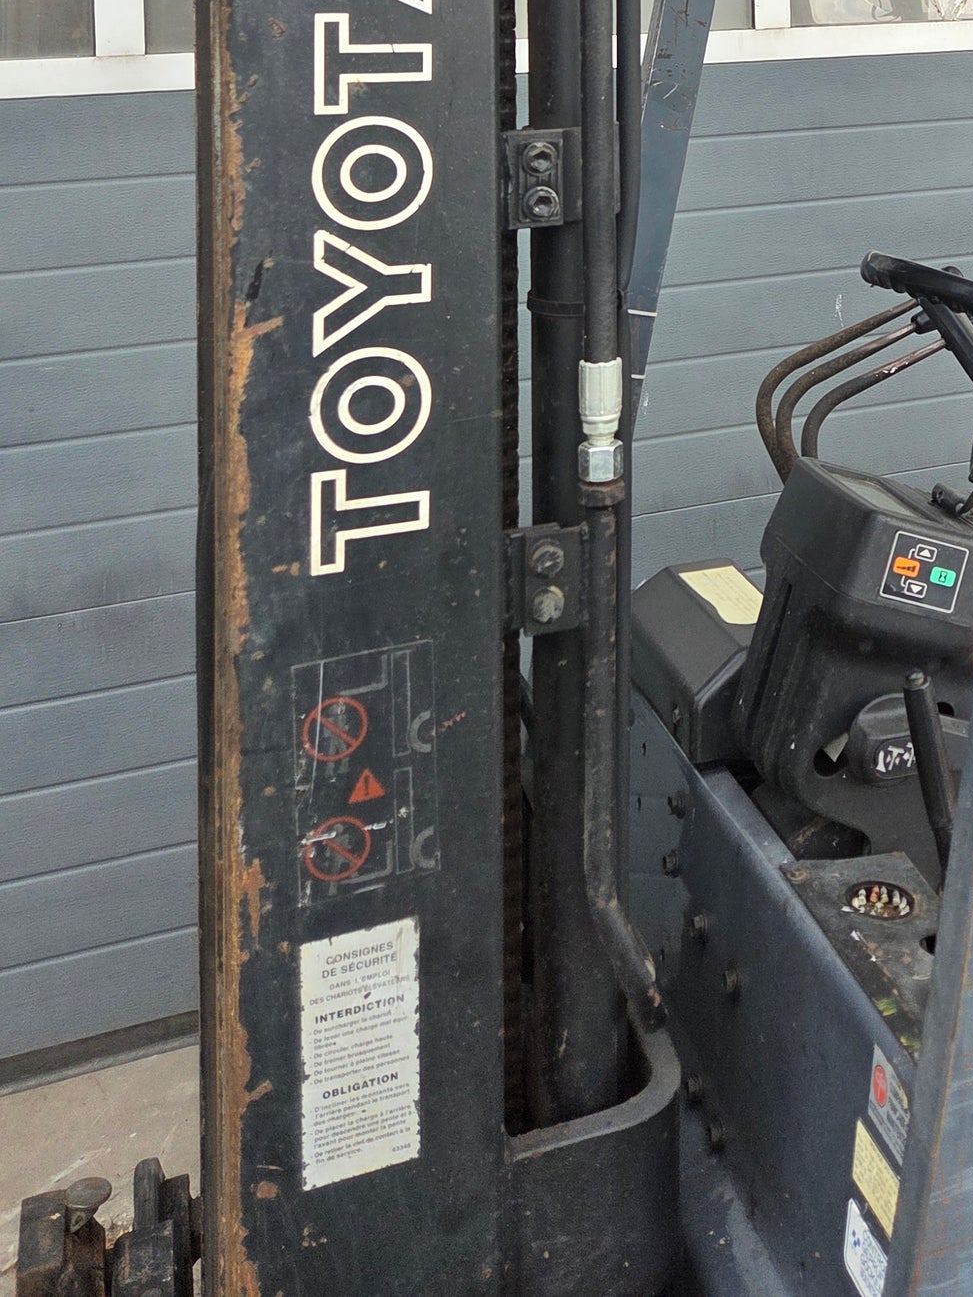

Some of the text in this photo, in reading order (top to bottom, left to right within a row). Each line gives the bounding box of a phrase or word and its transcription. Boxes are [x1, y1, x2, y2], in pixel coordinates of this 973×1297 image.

[322, 951, 397, 980] DE SÉCURITÉ
[326, 941, 394, 966] CONSIGNES
[309, 996, 324, 1006] DES
[326, 986, 362, 1002] CHARIOTS
[330, 979, 351, 990] DANS
[315, 993, 404, 1025] INTERDICTION
[322, 1071, 398, 1100] OBLIGATION
